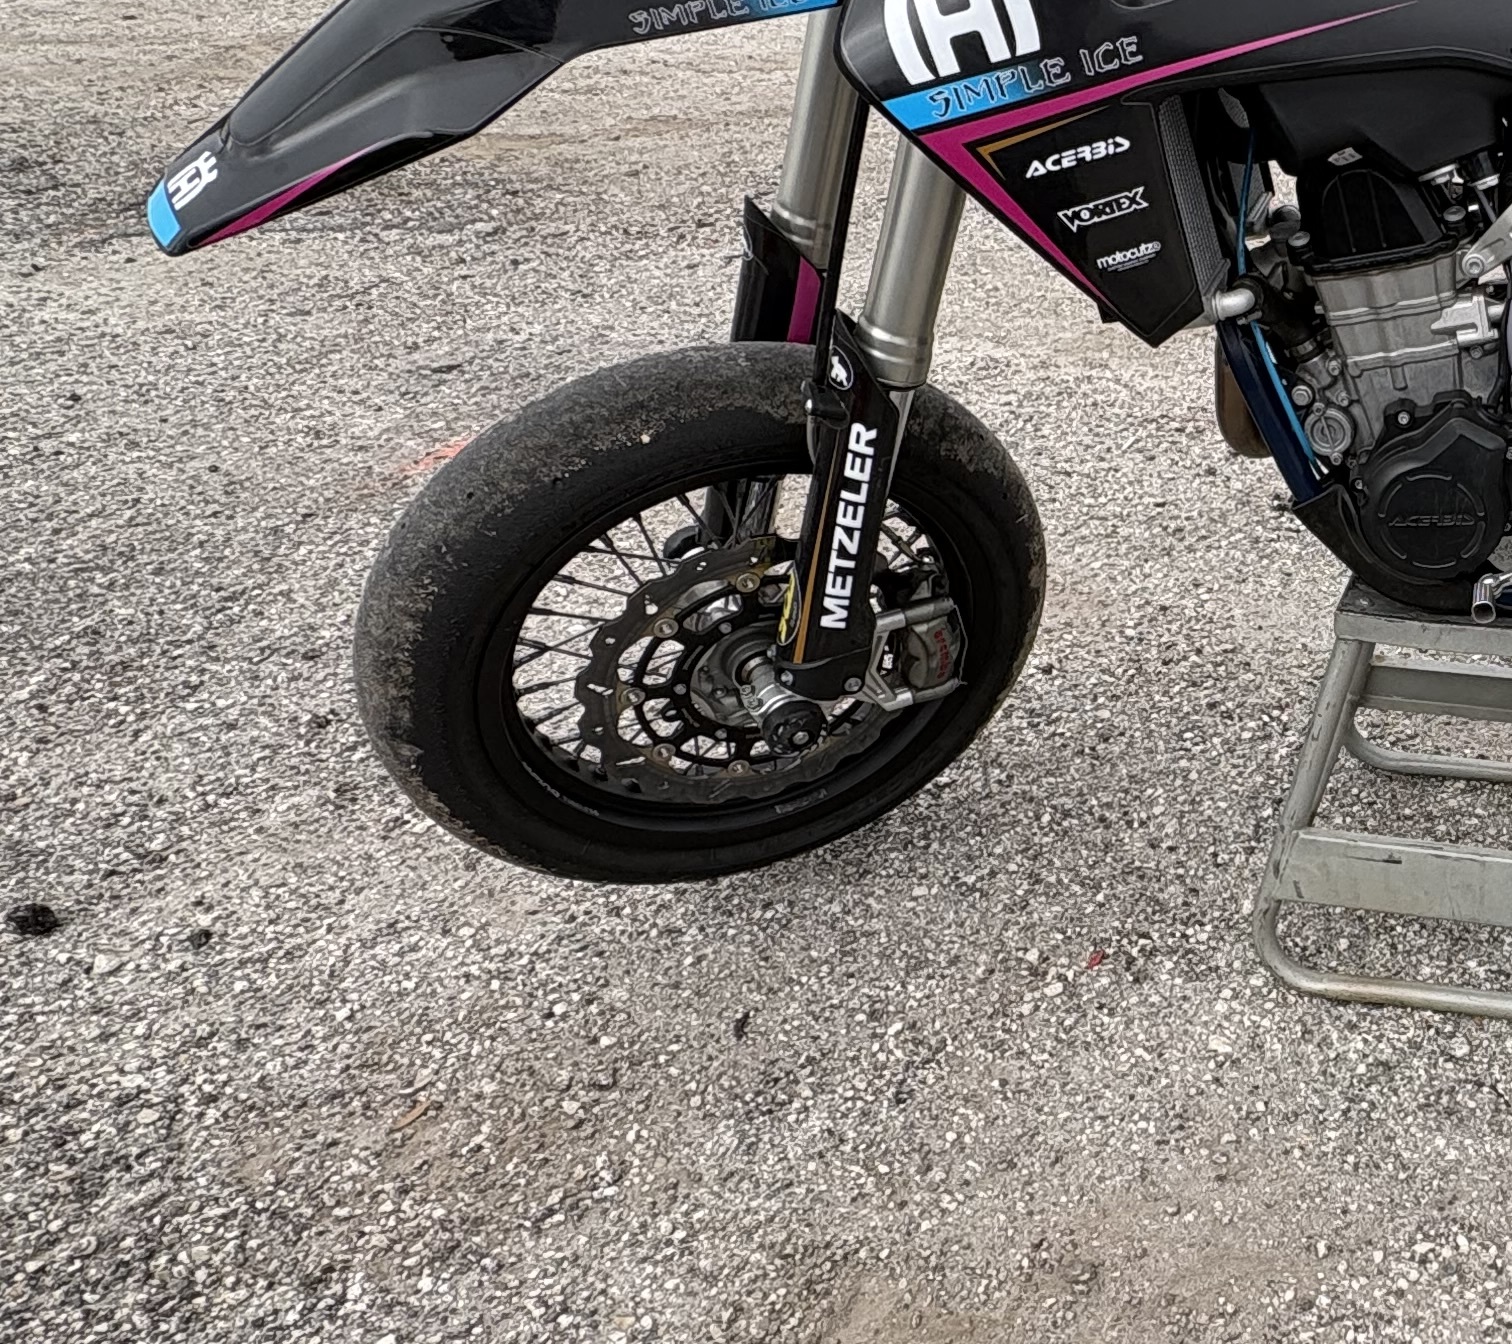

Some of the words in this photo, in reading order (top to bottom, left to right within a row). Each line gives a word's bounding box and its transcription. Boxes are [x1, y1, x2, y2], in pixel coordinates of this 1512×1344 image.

[928, 58, 1071, 119] SIMPLE
[1080, 35, 1144, 77] ICE
[1024, 135, 1131, 179] ACERBIS
[1057, 186, 1149, 233] VORTEX
[821, 421, 878, 630] METZELER
